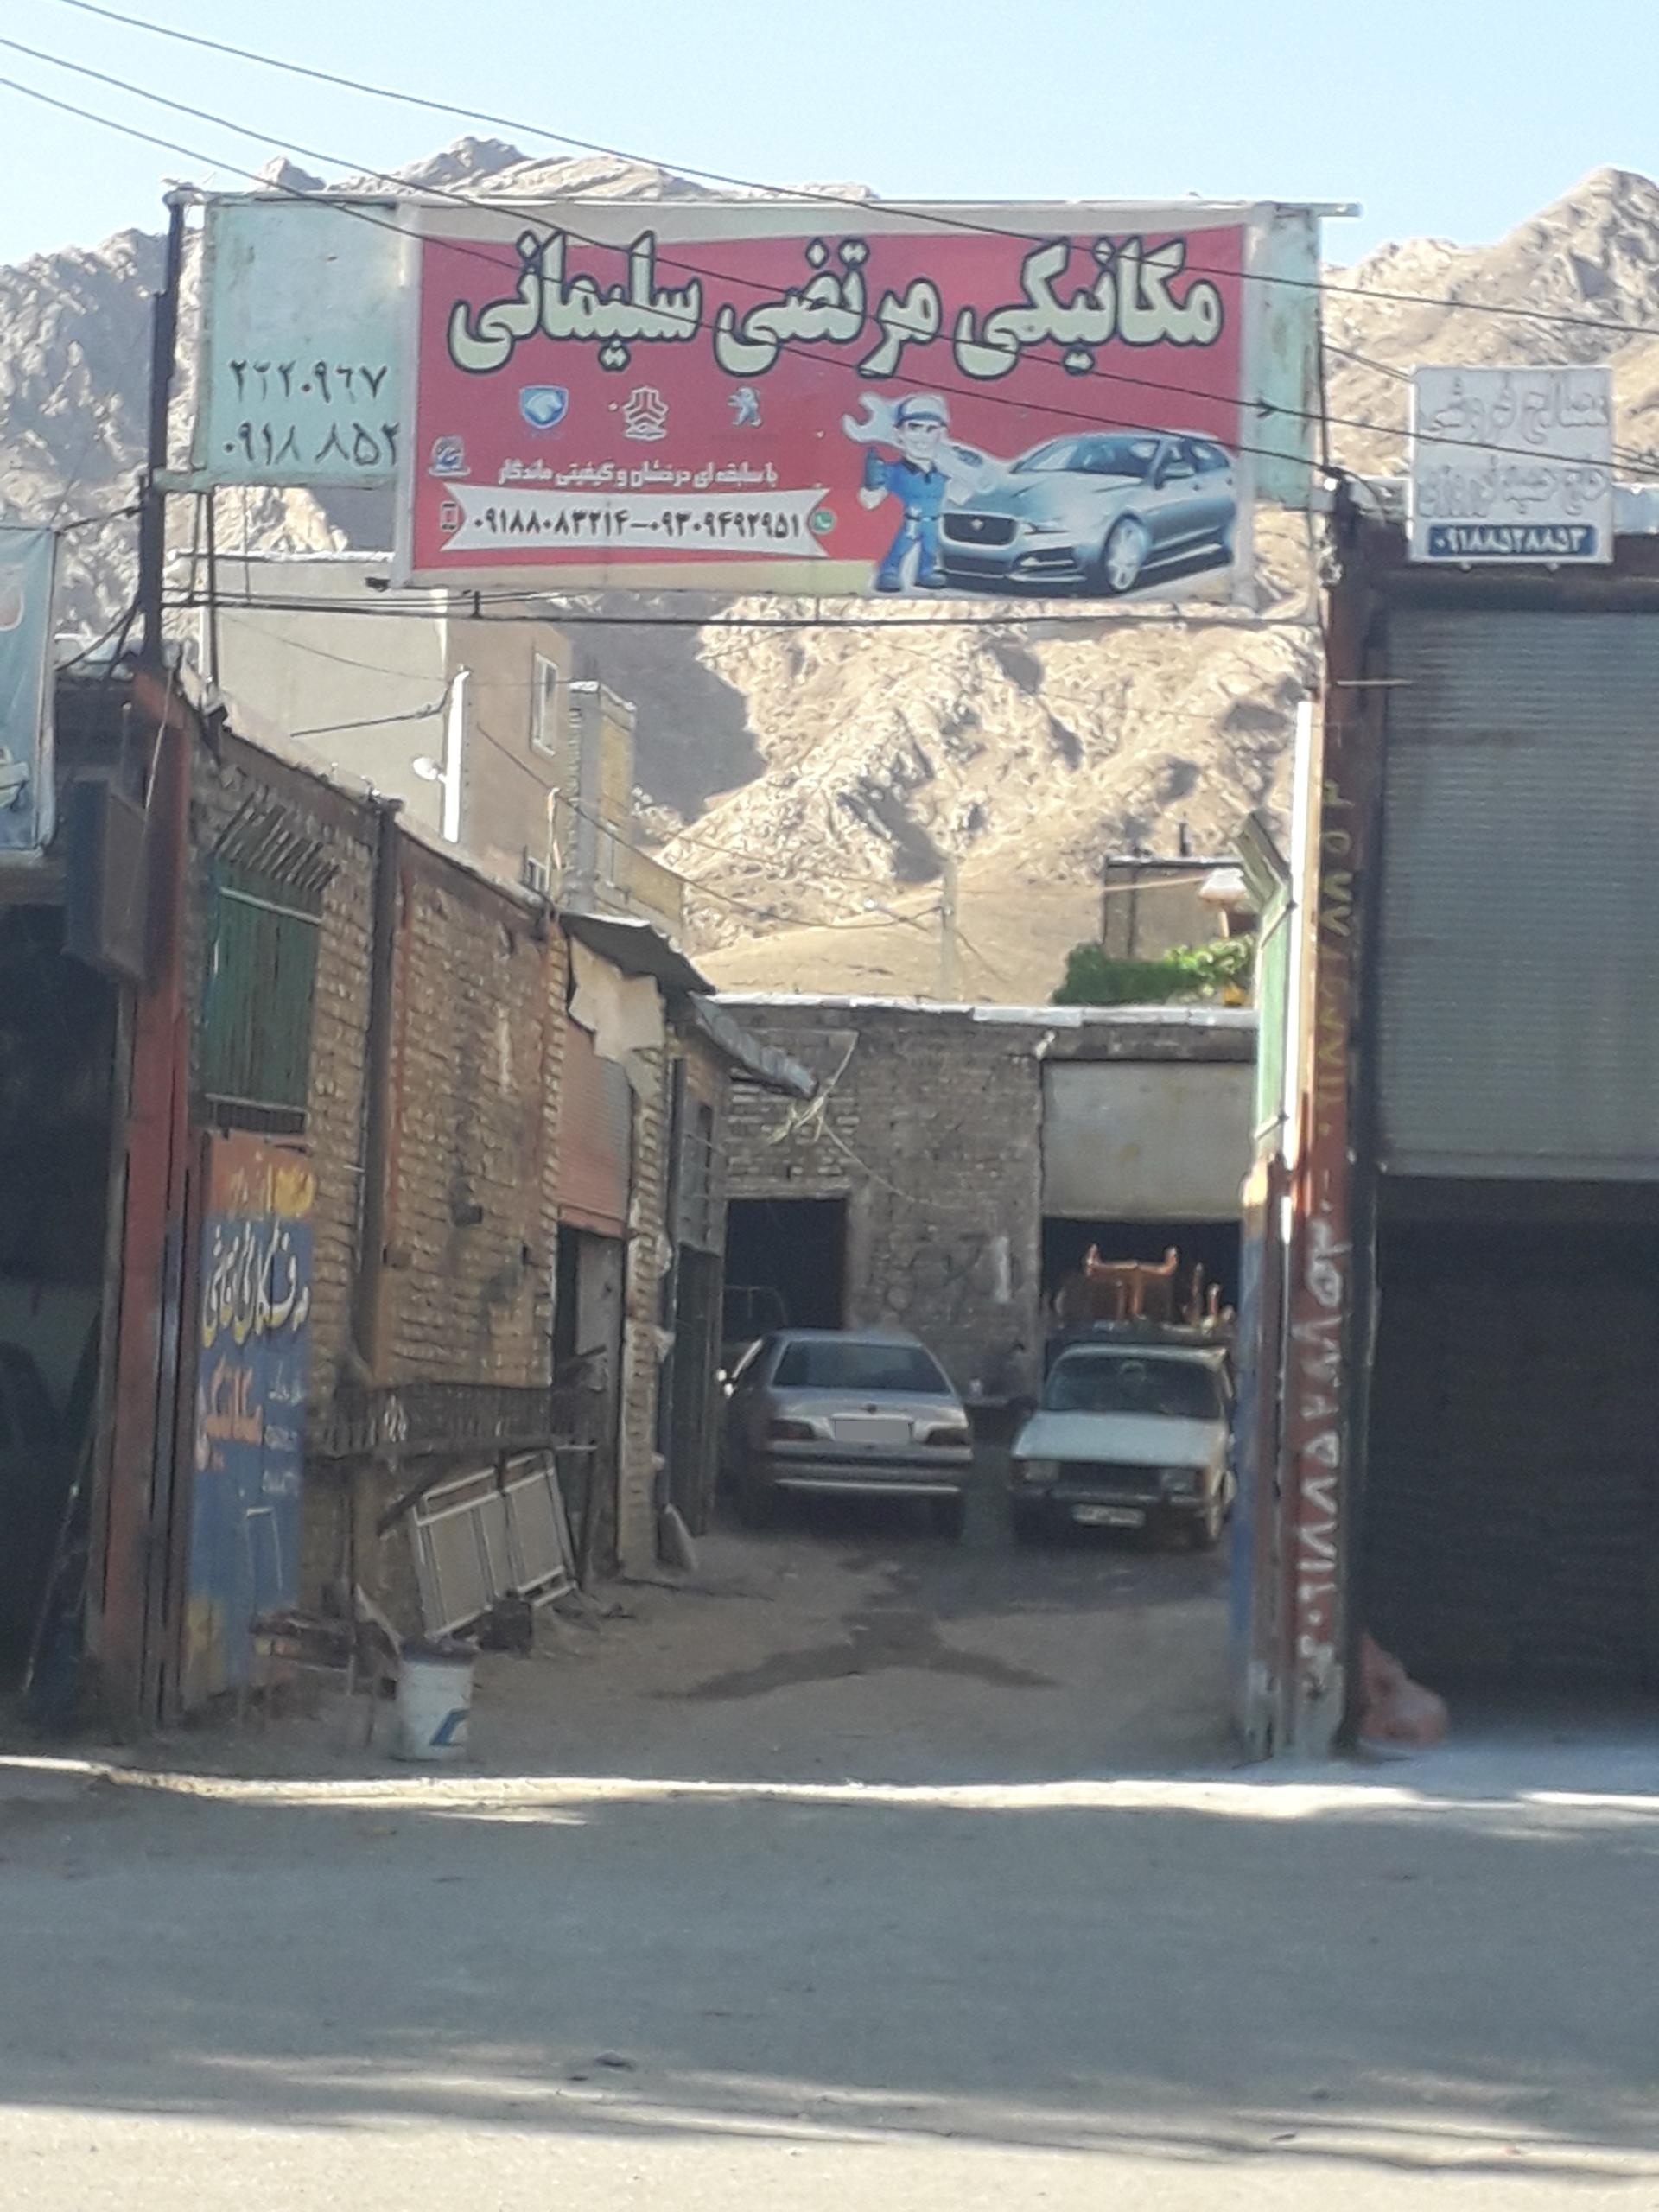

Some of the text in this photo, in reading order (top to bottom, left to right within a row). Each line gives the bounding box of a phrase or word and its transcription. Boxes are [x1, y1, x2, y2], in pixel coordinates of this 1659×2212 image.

[448, 230, 1224, 379] مکانیکی مرتضی سلیمانی
[224, 422, 301, 467] ۰۹۱۸
[498, 457, 555, 486] ماندگار
[616, 467, 628, 487] و
[630, 459, 692, 487] درخشان
